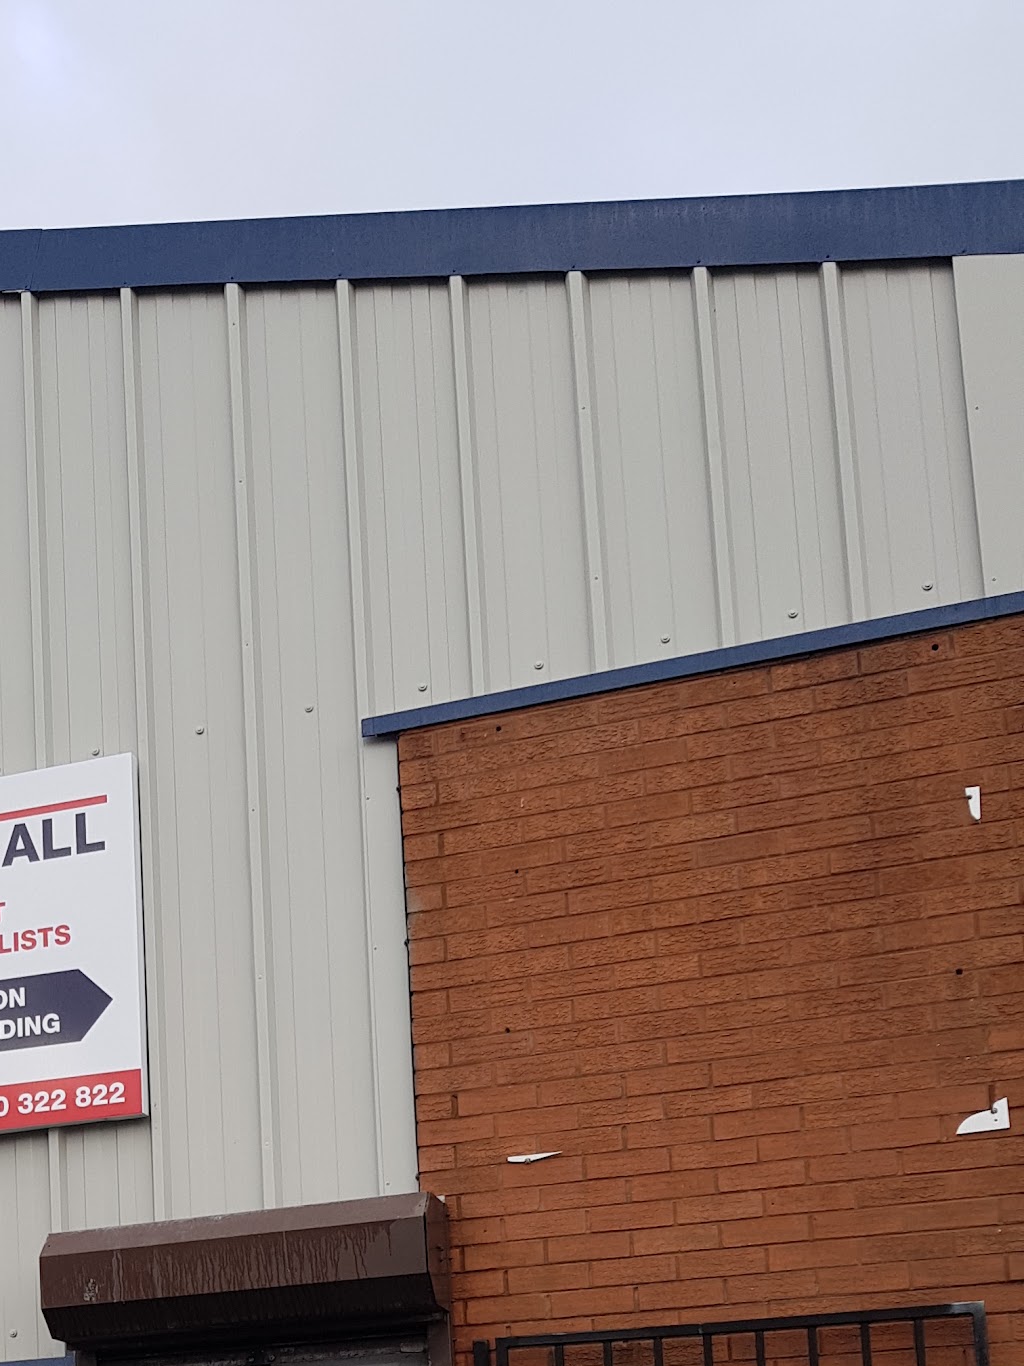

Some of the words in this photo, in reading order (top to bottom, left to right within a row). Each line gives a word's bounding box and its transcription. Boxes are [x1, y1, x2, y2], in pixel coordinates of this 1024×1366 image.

[1, 812, 106, 867] ALL
[17, 1088, 67, 1115] 322
[74, 1081, 126, 1108] 822
